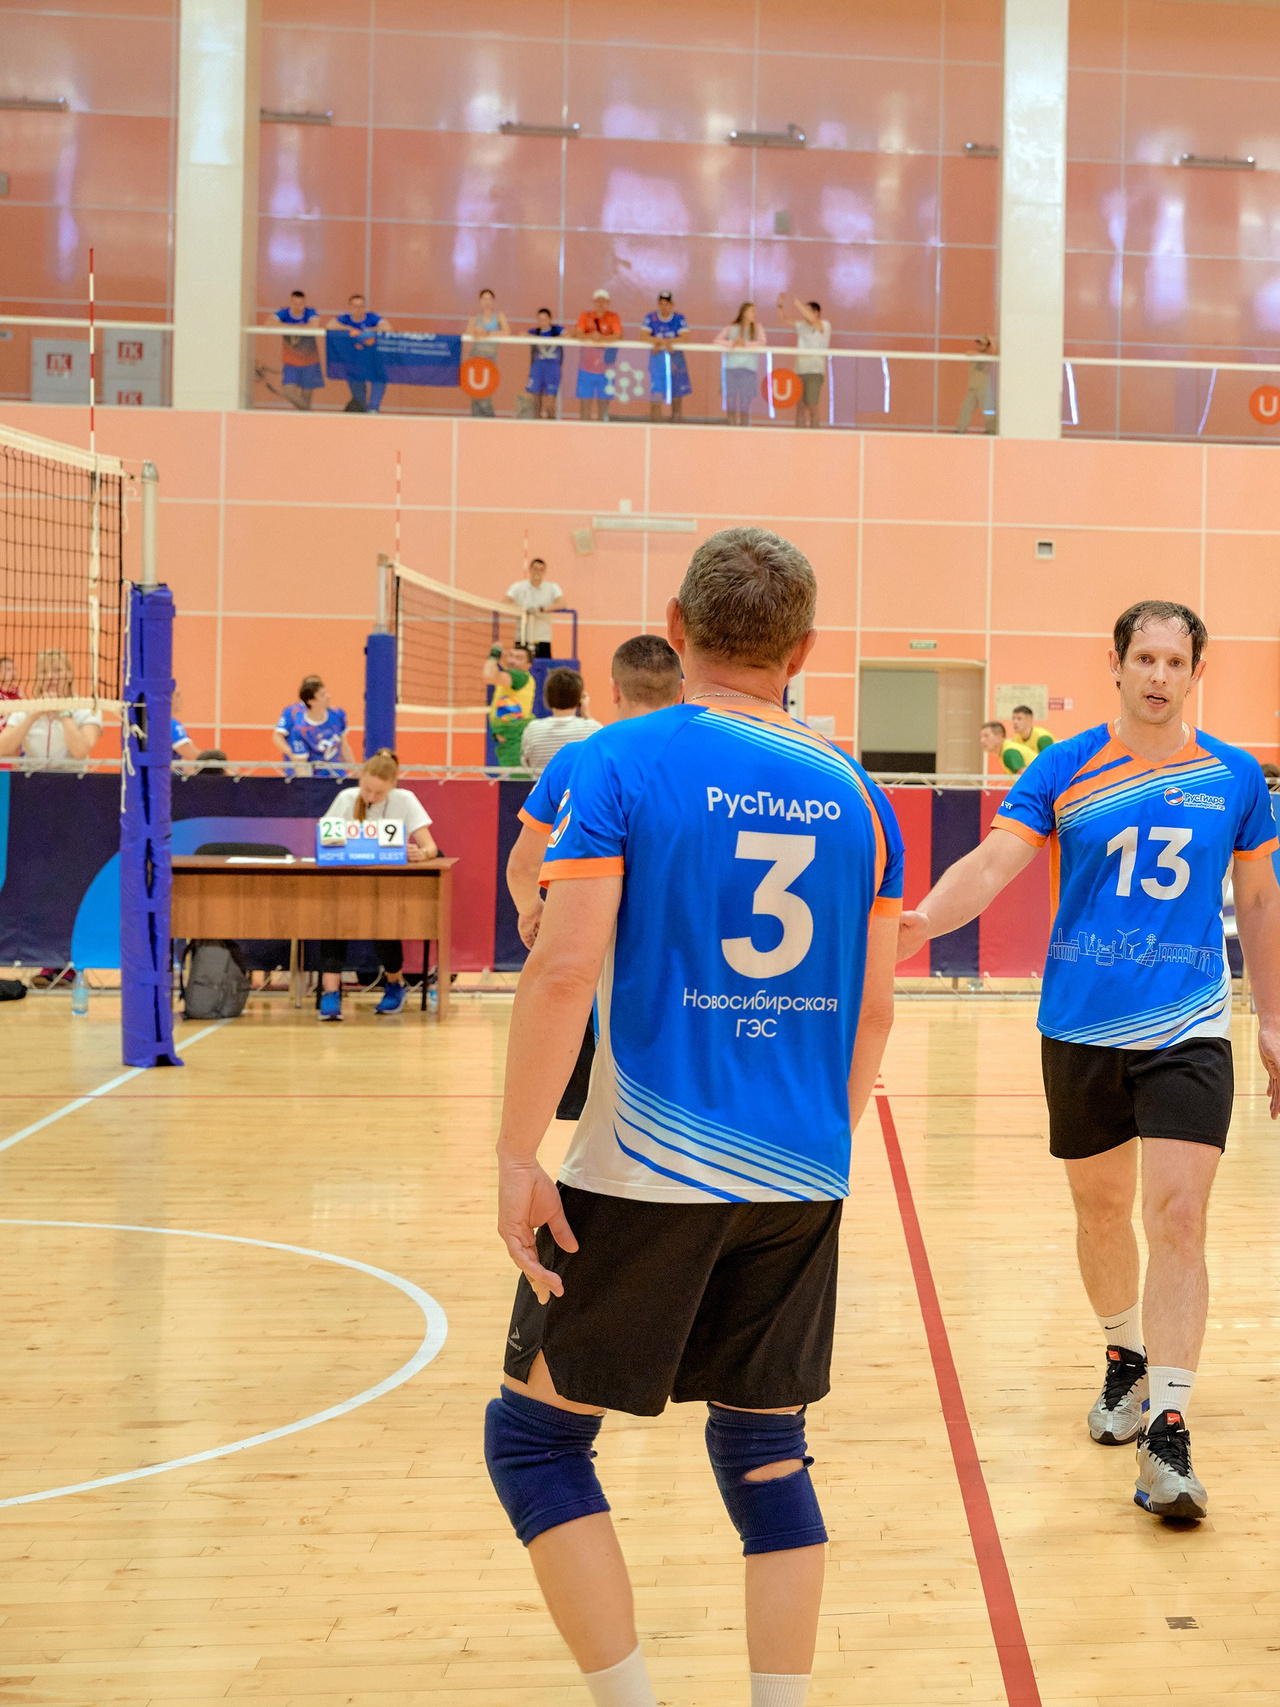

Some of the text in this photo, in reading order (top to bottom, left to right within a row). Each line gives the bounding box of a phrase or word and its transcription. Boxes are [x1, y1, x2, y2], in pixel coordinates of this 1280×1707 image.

[467, 366, 490, 390] U
[772, 377, 792, 401] U
[1259, 395, 1278, 417] U
[706, 786, 842, 825] РусГидро
[347, 824, 359, 838] 0
[365, 824, 378, 838] 0
[384, 823, 398, 842] 9
[1106, 826, 1193, 901] 13
[721, 830, 817, 979] 3
[683, 987, 839, 1015] Новосибирская
[735, 1018, 778, 1038] ГЭС
